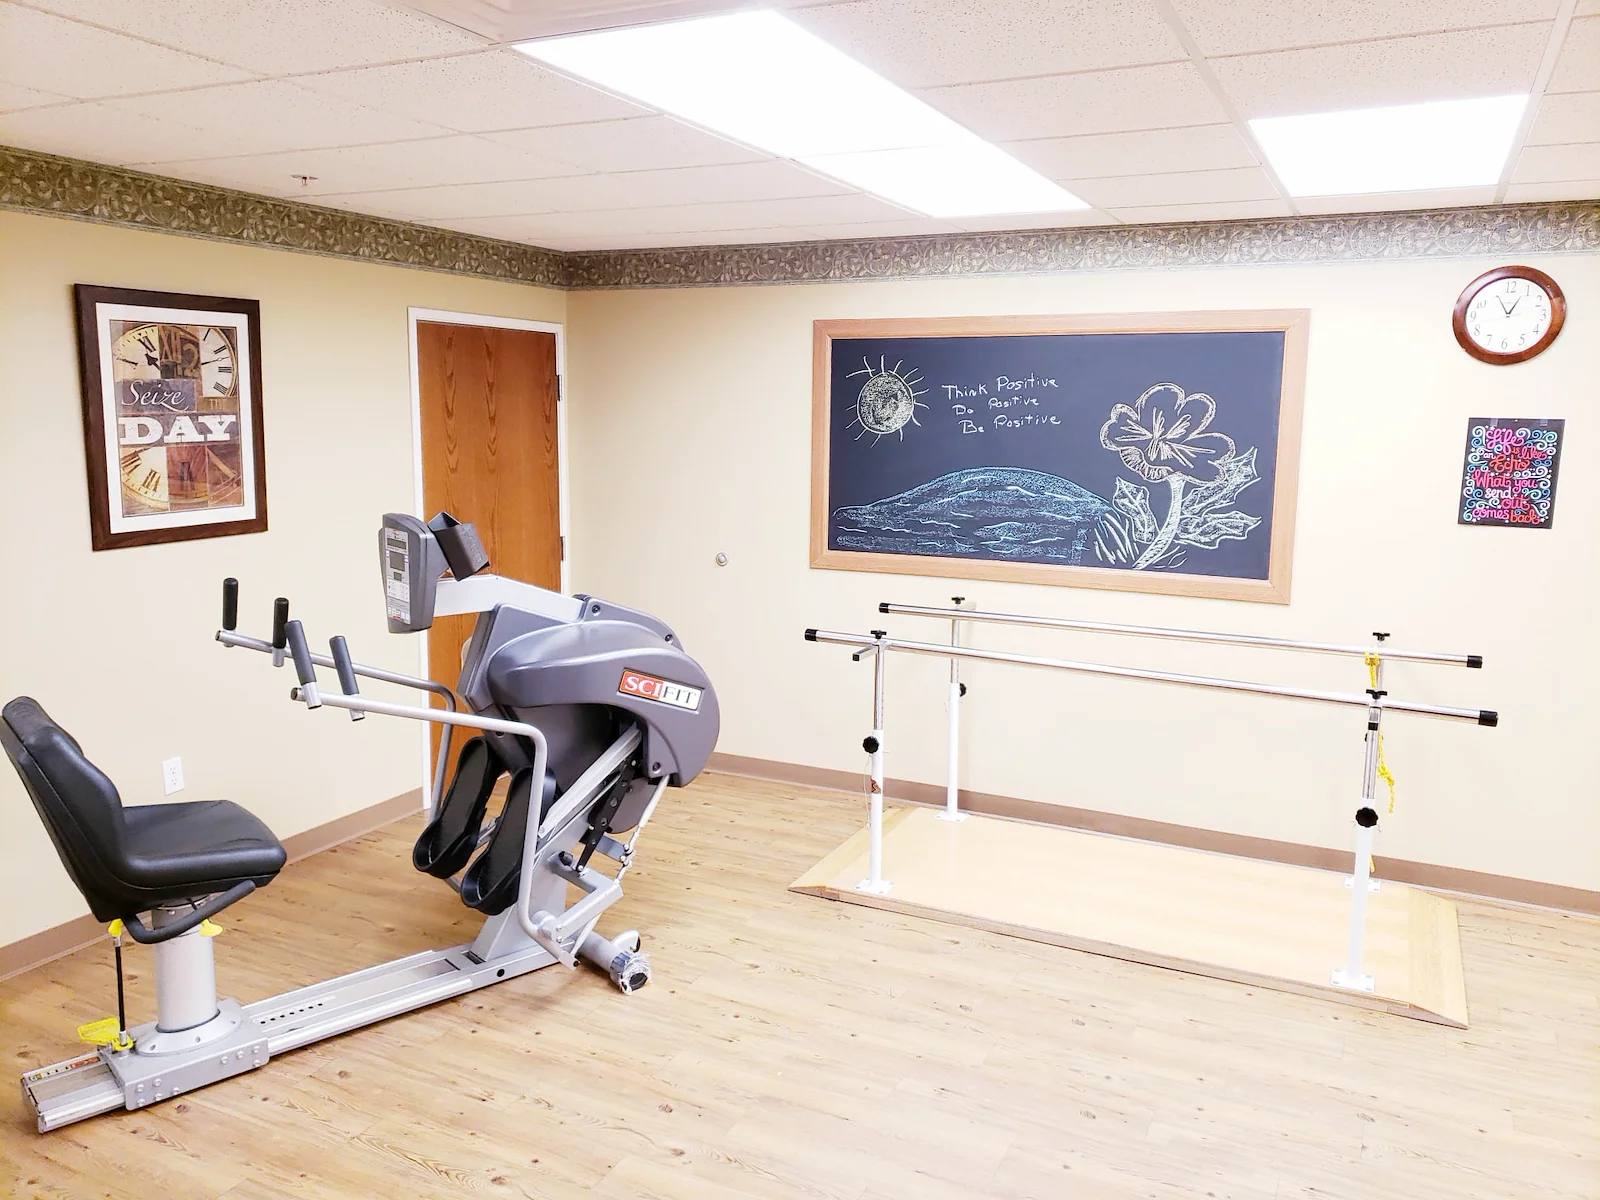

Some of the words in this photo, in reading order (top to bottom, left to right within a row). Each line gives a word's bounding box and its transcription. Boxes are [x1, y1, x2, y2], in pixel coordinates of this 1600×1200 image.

[1535, 295, 1543, 307] 2
[1470, 310, 1477, 323] 9
[1540, 309, 1547, 321] 3
[1473, 324, 1481, 337] 8
[1532, 324, 1540, 335] 4
[1486, 334, 1493, 346] 7
[1501, 337, 1508, 350] 6
[1518, 333, 1526, 346] 5
[941, 383, 989, 400] Think
[996, 372, 1059, 392] Positive
[121, 380, 190, 413] Seize
[951, 404, 975, 416] Do
[987, 395, 1040, 410] Positive
[118, 414, 236, 445] DAY
[958, 419, 985, 434] Be
[993, 414, 1061, 430] Positive
[1518, 445, 1547, 460] like
[1489, 454, 1530, 473] Echo
[1472, 469, 1513, 488] What
[1512, 478, 1538, 494] you
[1484, 485, 1514, 499] send
[1472, 507, 1509, 520] comes
[1510, 509, 1540, 525] back
[624, 675, 698, 705] SCIFIT
